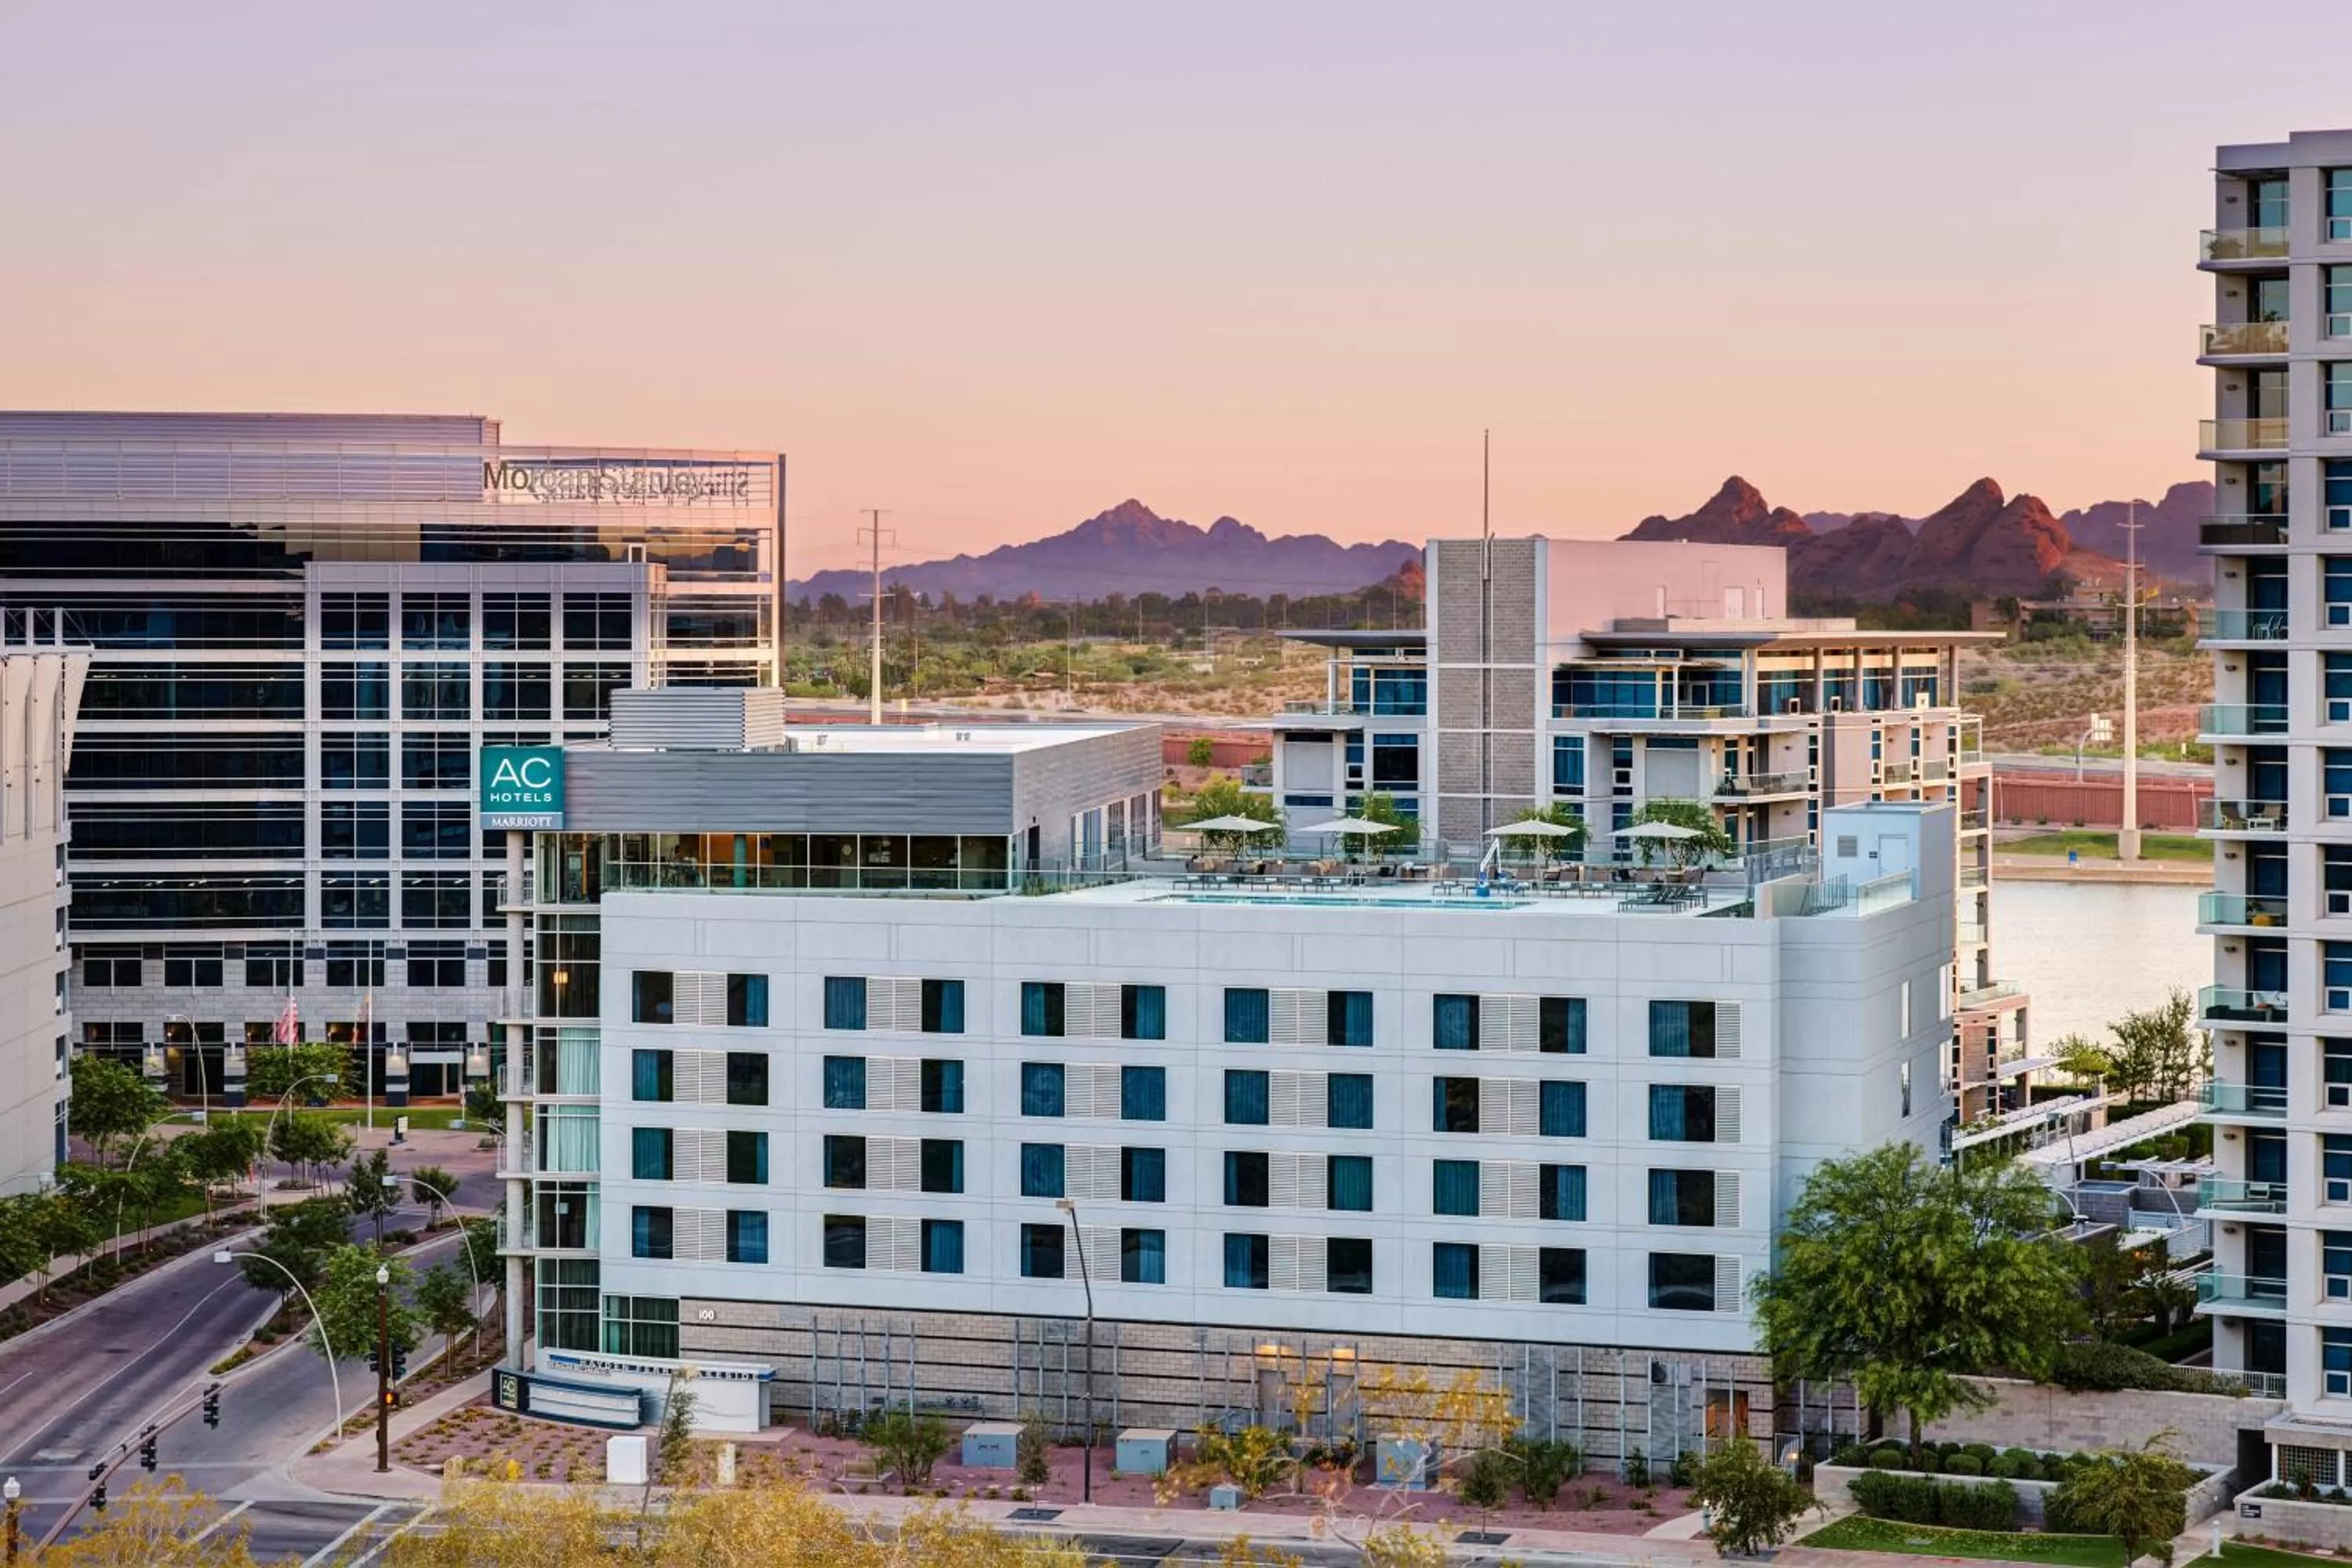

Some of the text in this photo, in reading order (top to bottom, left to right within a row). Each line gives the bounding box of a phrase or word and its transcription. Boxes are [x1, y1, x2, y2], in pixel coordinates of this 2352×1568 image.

[484, 461, 595, 498] Morgan
[490, 757, 552, 789] AC
[490, 793, 553, 803] HOTELS
[492, 816, 553, 827] MARRIOTT
[699, 1310, 714, 1320] 100
